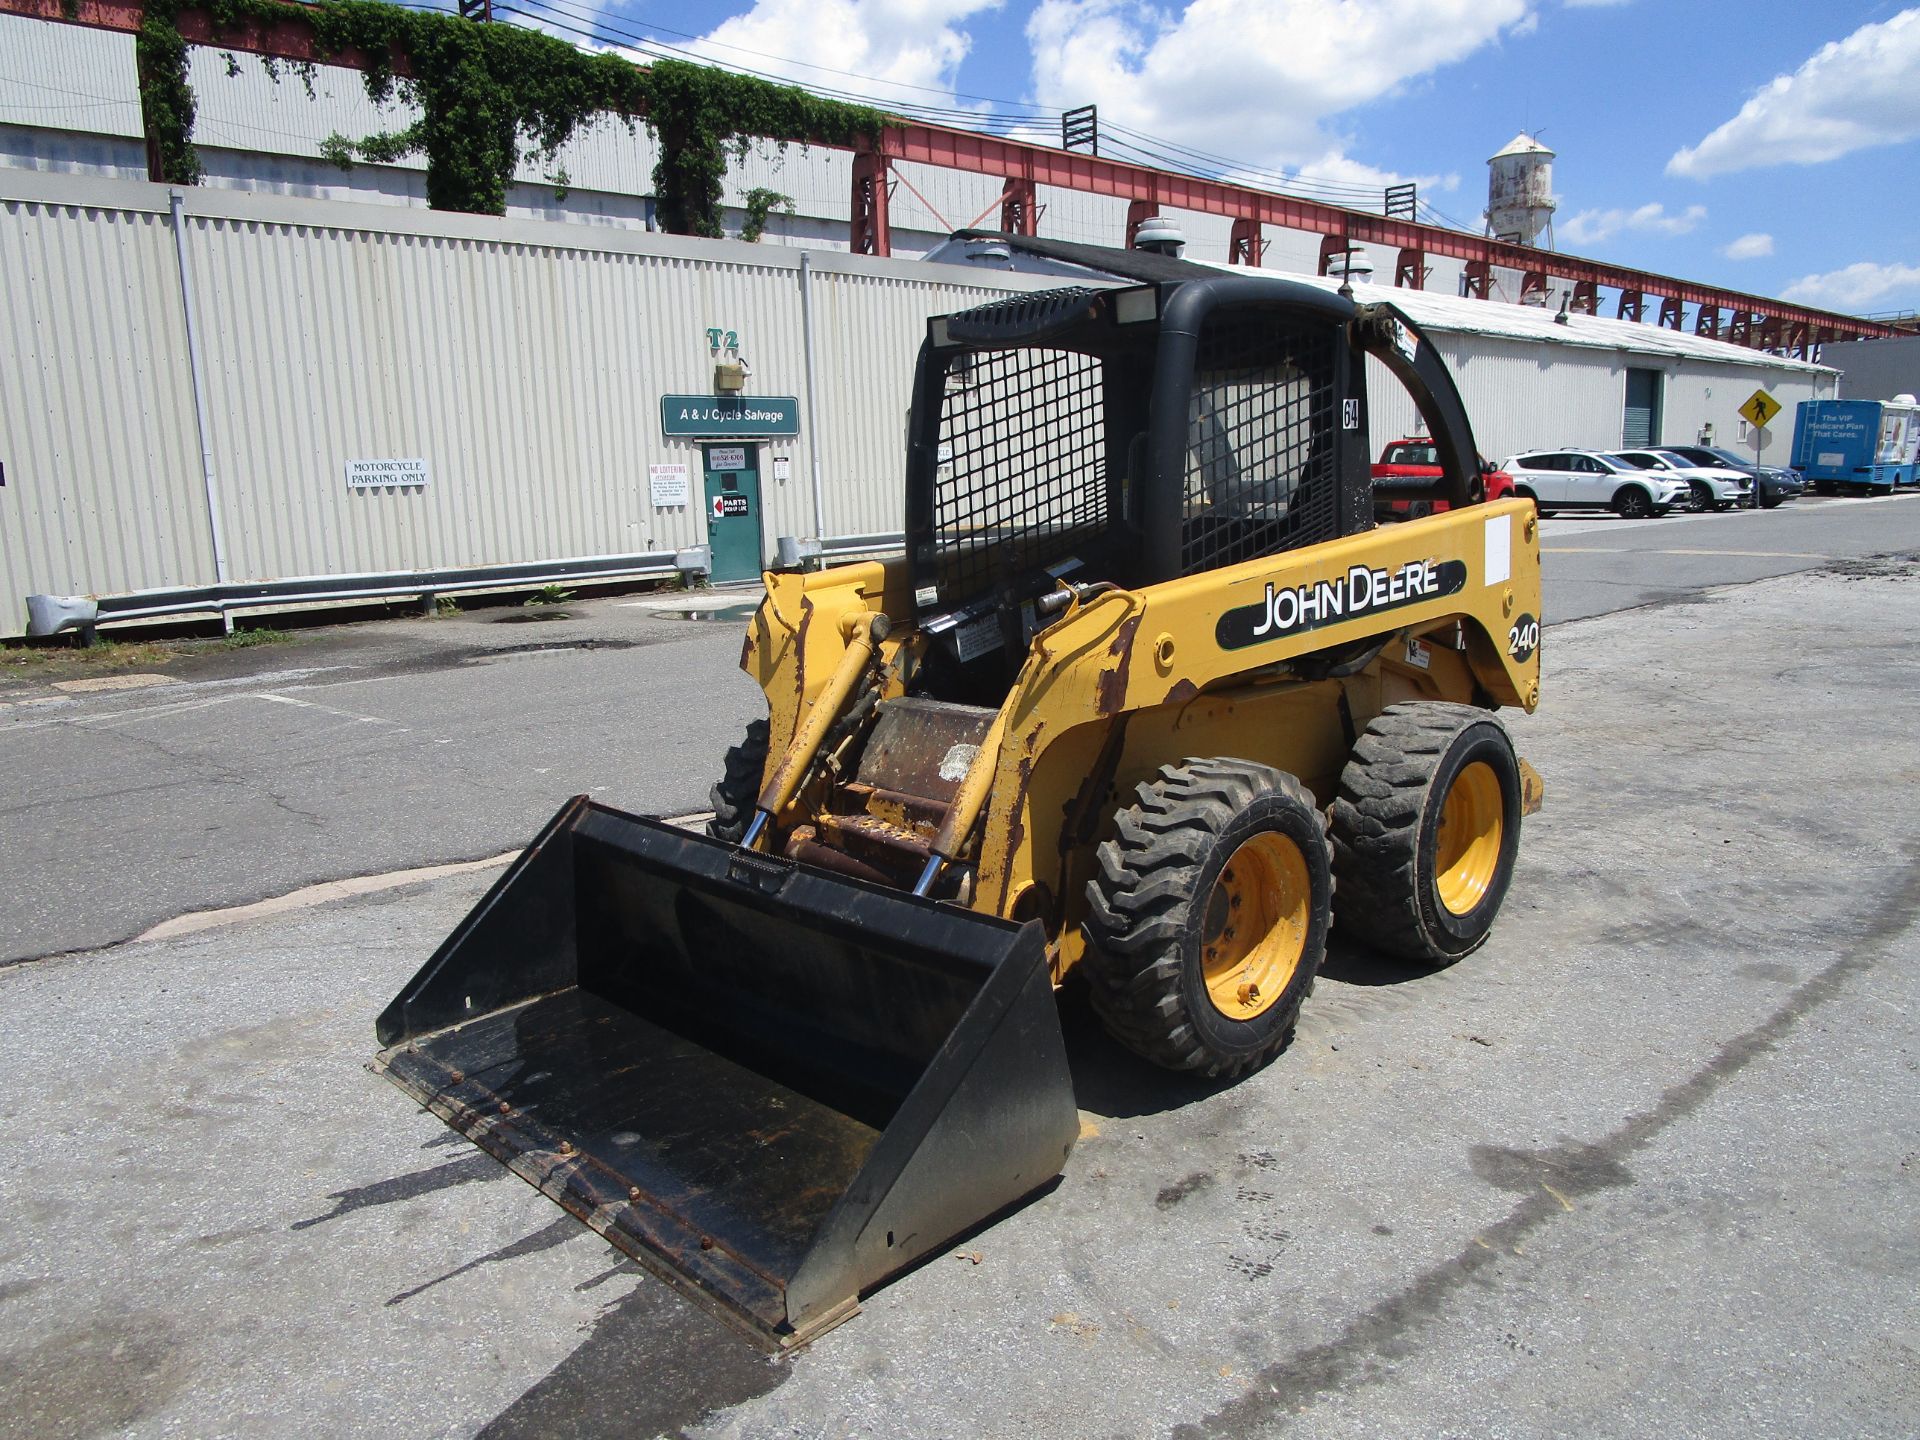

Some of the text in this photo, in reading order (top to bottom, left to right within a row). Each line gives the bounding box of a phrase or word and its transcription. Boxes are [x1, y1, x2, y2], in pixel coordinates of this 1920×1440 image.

[706, 328, 739, 349] T2
[680, 409, 783, 424] A & J Cycle Salvage
[1344, 400, 1357, 427] 64
[1846, 422, 1864, 430] Plan
[354, 462, 422, 472] MOTORCYCLE
[352, 473, 426, 484] PARKING ONLY
[724, 499, 747, 507] PARTS
[1254, 562, 1439, 636] JOHN DEERE
[1508, 622, 1539, 655] 240
